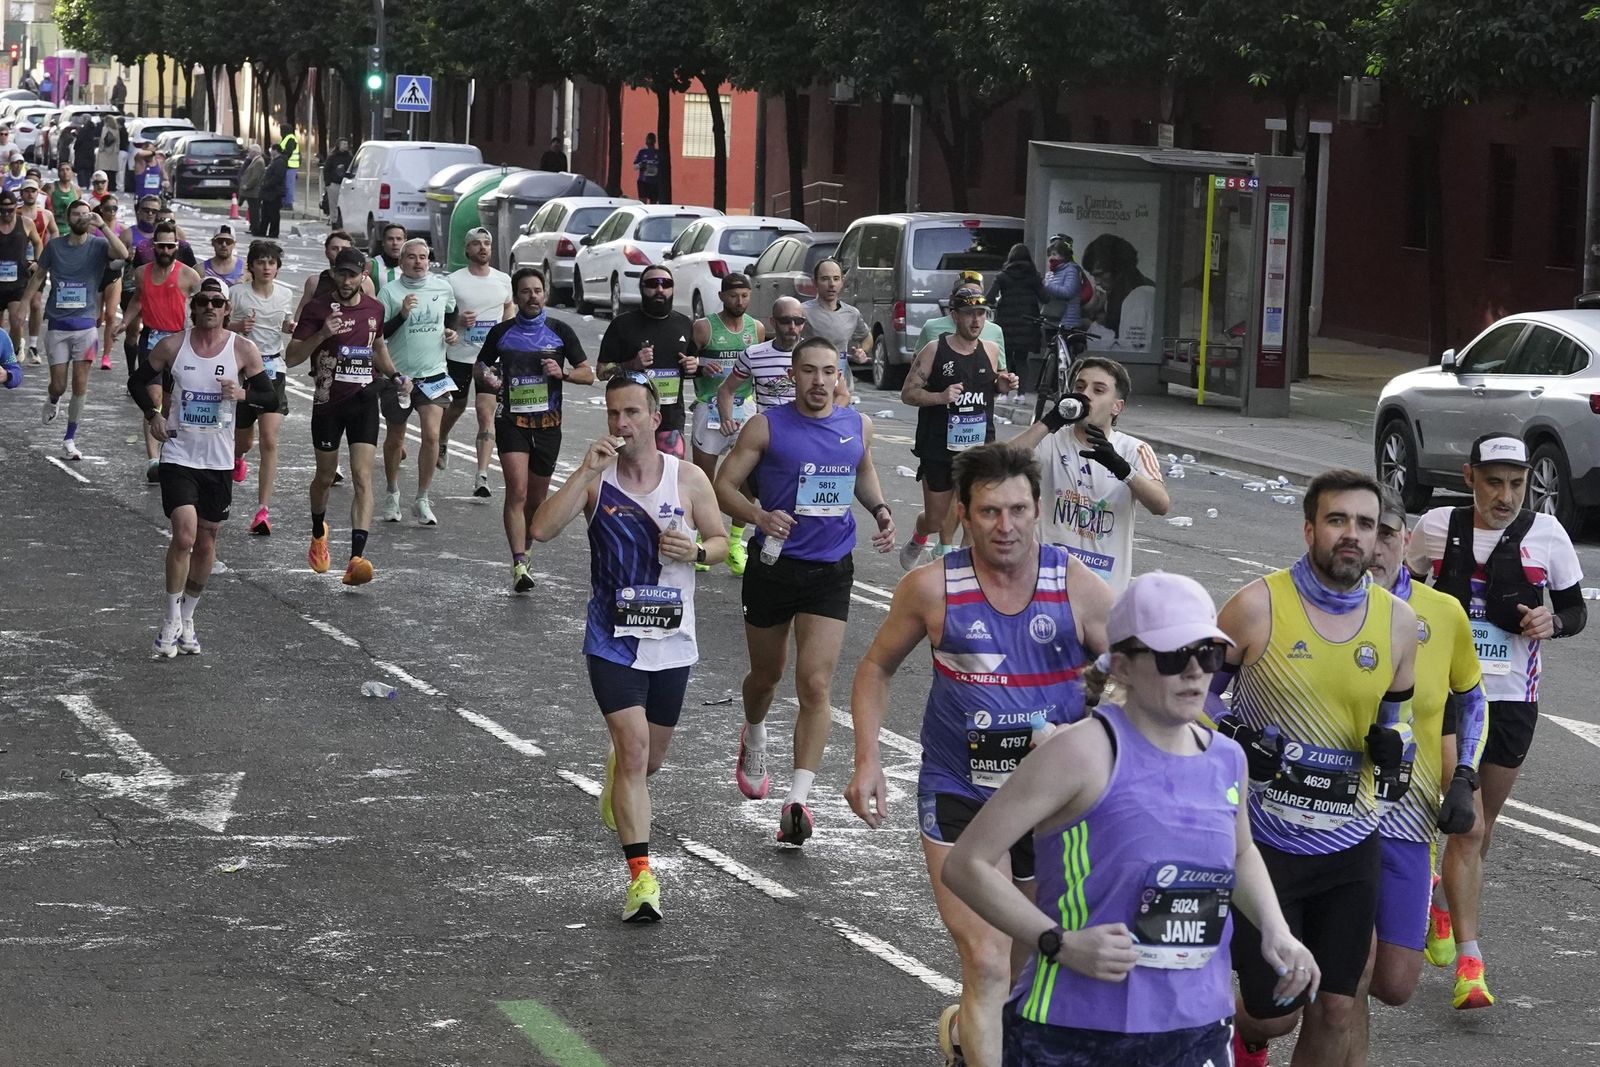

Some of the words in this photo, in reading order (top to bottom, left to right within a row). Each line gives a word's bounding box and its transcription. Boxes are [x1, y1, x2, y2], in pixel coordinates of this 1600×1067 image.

[1214, 179, 1225, 187] C2
[1228, 179, 1235, 187] 5
[1239, 179, 1246, 187] 6
[1248, 179, 1259, 187] 43
[346, 366, 372, 376] VÁZQUEZ
[430, 380, 448, 392] DIEGO
[183, 413, 217, 424] NUNOLA
[962, 415, 984, 424] ZURICH
[954, 434, 980, 443] TAYLER
[819, 465, 851, 473] ZURICH
[818, 481, 837, 490] 5812
[812, 492, 840, 504] JACK
[1072, 552, 1110, 568] ZURICH
[639, 588, 678, 600] ZURICH
[639, 605, 661, 615] 4737
[626, 614, 672, 628] MONTY
[1472, 629, 1489, 639] 390
[1474, 643, 1508, 658] HTAR
[998, 708, 1048, 725] ZURICH
[1000, 736, 1028, 749] 4797
[1308, 751, 1354, 766] ZURICH
[970, 758, 1018, 772] CARLOS
[1303, 774, 1331, 789] 4629
[1264, 788, 1312, 809] SUÁREZ
[1313, 799, 1354, 815] ROVIRA
[1179, 870, 1233, 884] ZURICH
[1170, 898, 1199, 914] 5024
[1161, 920, 1207, 943] JANE
